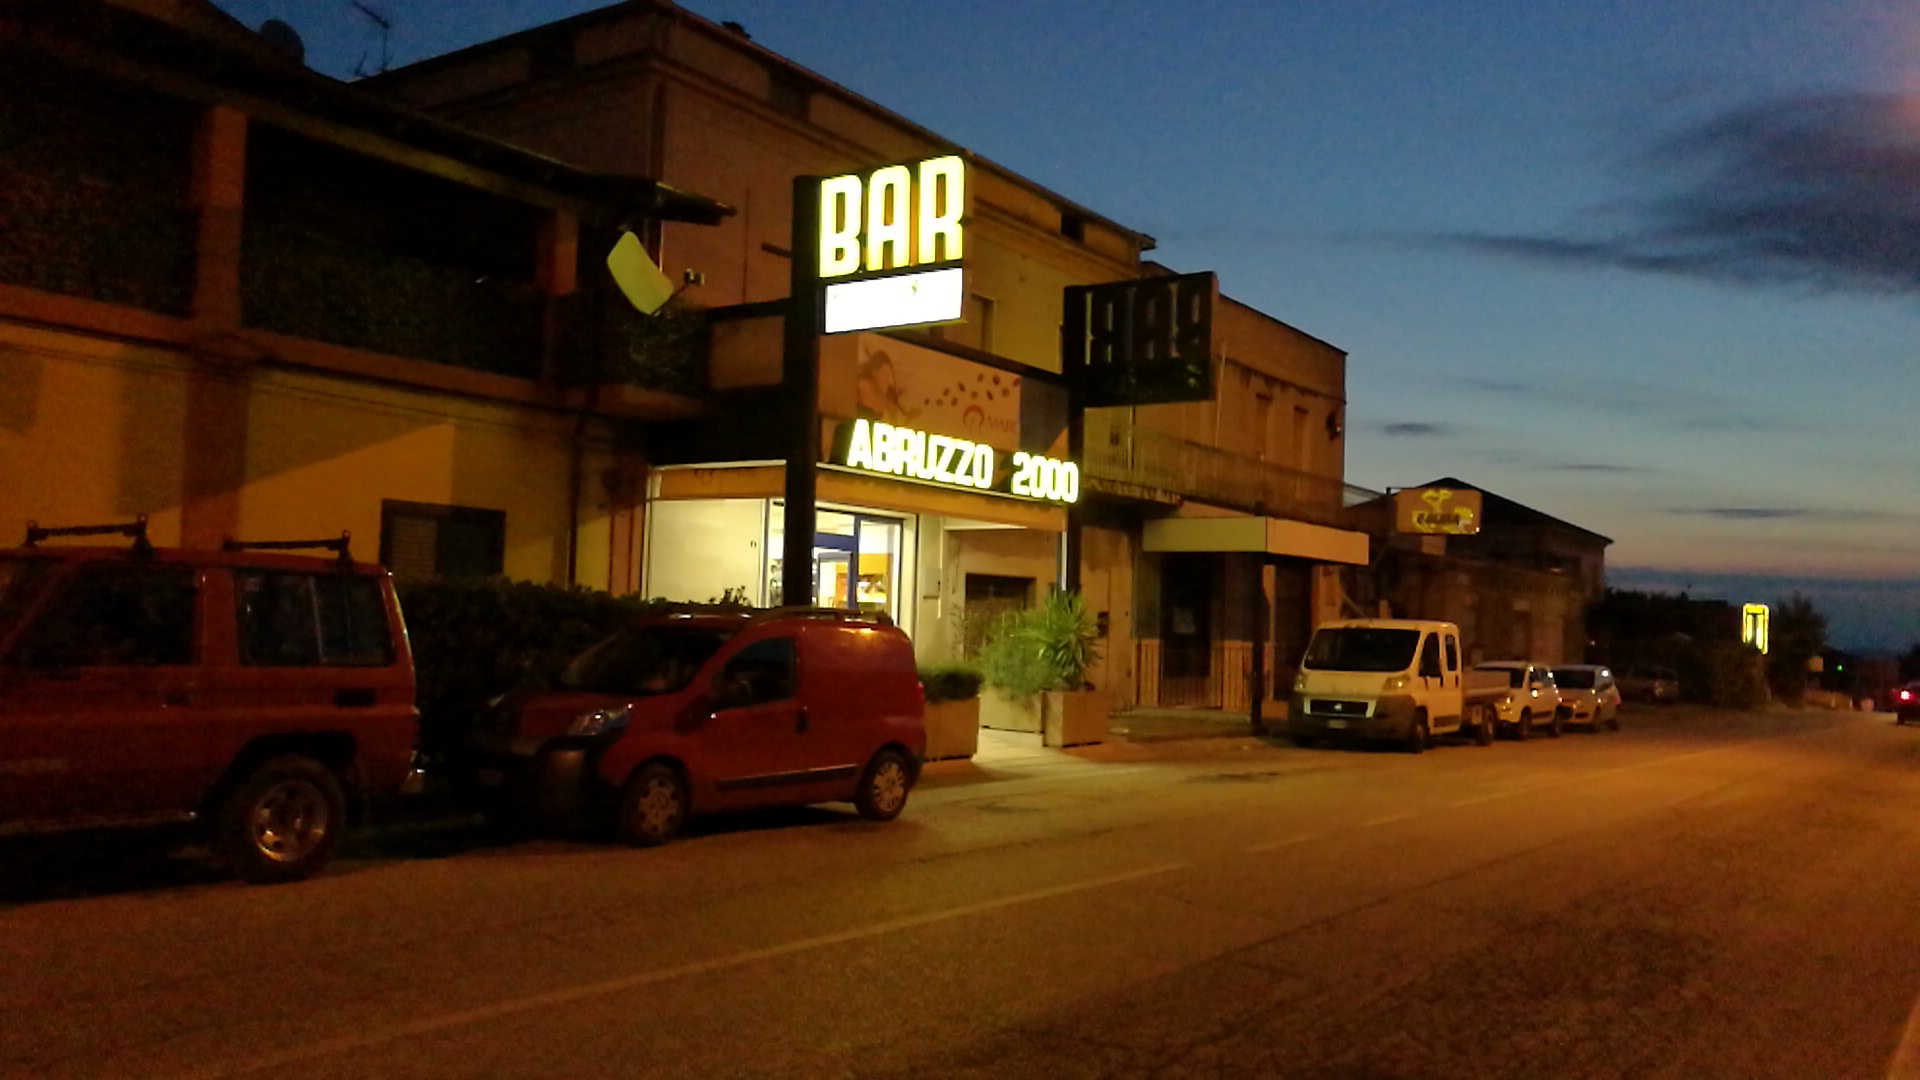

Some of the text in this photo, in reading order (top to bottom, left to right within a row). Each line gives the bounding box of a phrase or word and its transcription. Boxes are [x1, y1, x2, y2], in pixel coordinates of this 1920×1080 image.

[819, 156, 964, 277] BAR
[847, 419, 1079, 502] ABRUZZO 2000
